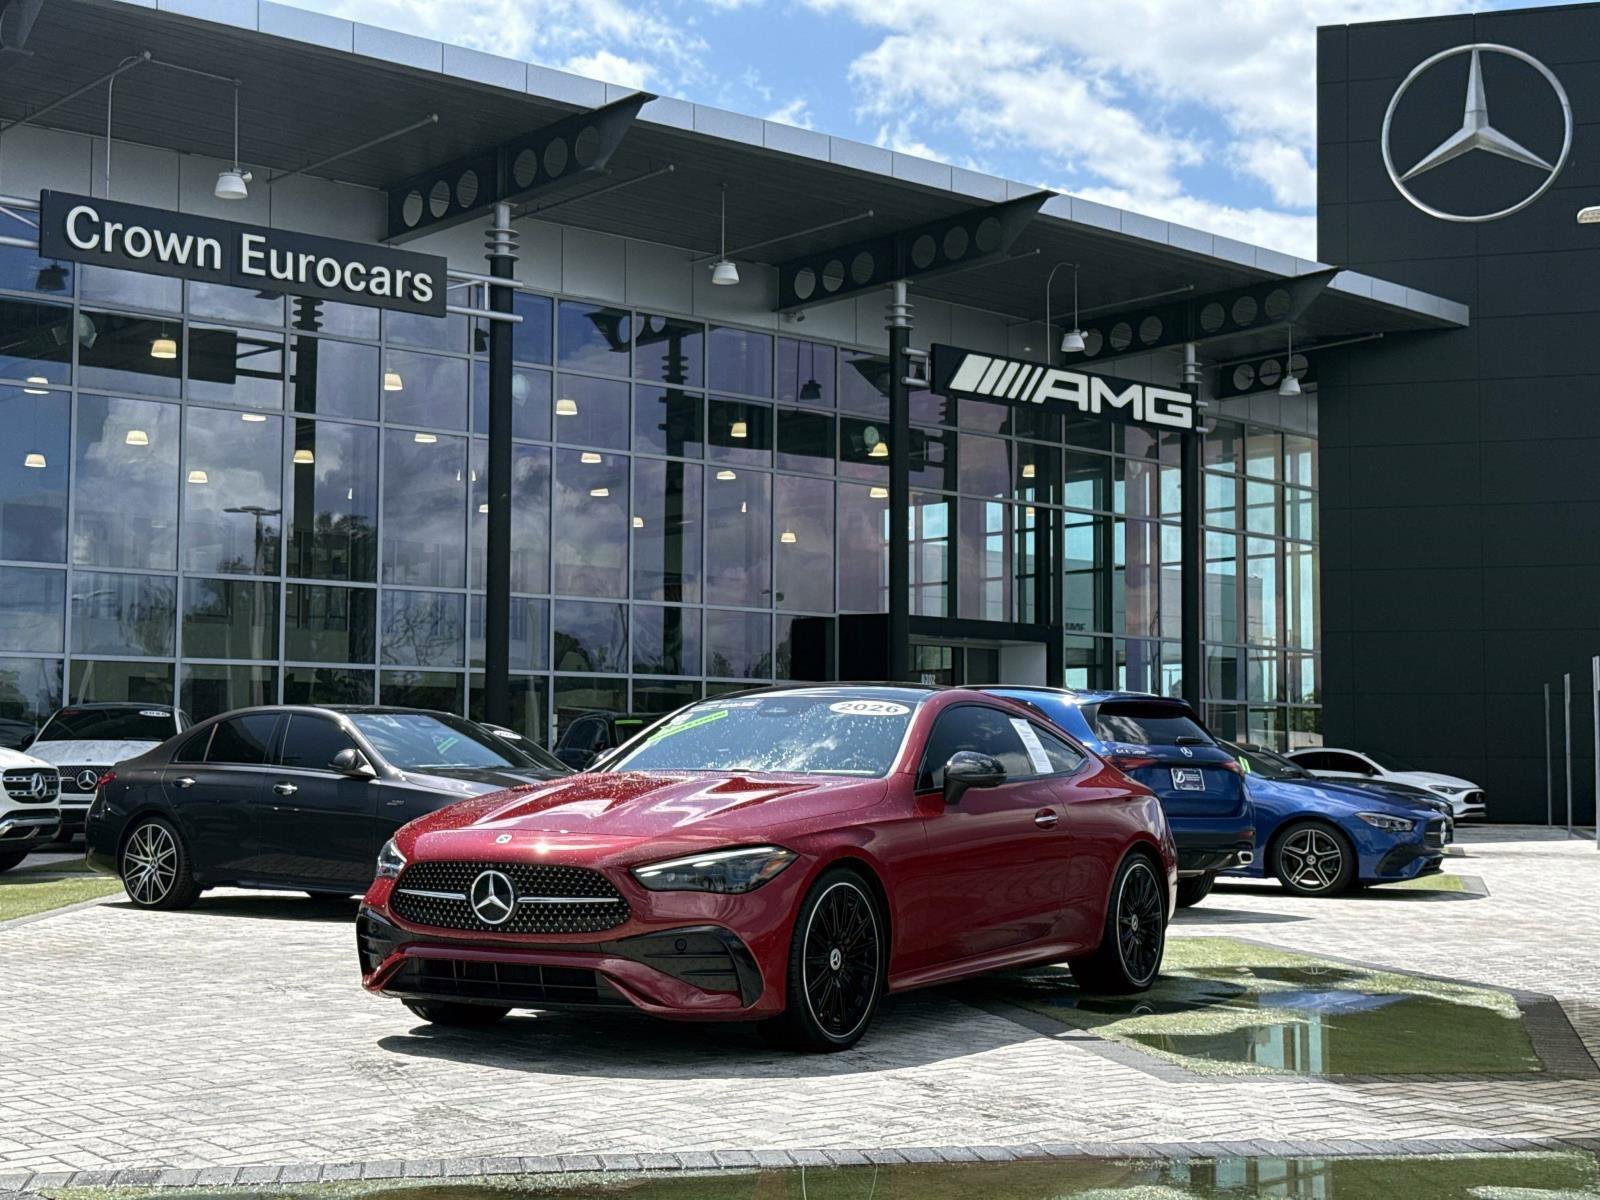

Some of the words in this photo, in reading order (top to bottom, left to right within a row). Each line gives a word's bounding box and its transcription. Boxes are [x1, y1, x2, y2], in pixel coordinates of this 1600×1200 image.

[65, 204, 222, 271] Crown
[242, 233, 435, 304] Eurocars
[1033, 369, 1193, 429] AMG
[838, 703, 901, 713] 2026
